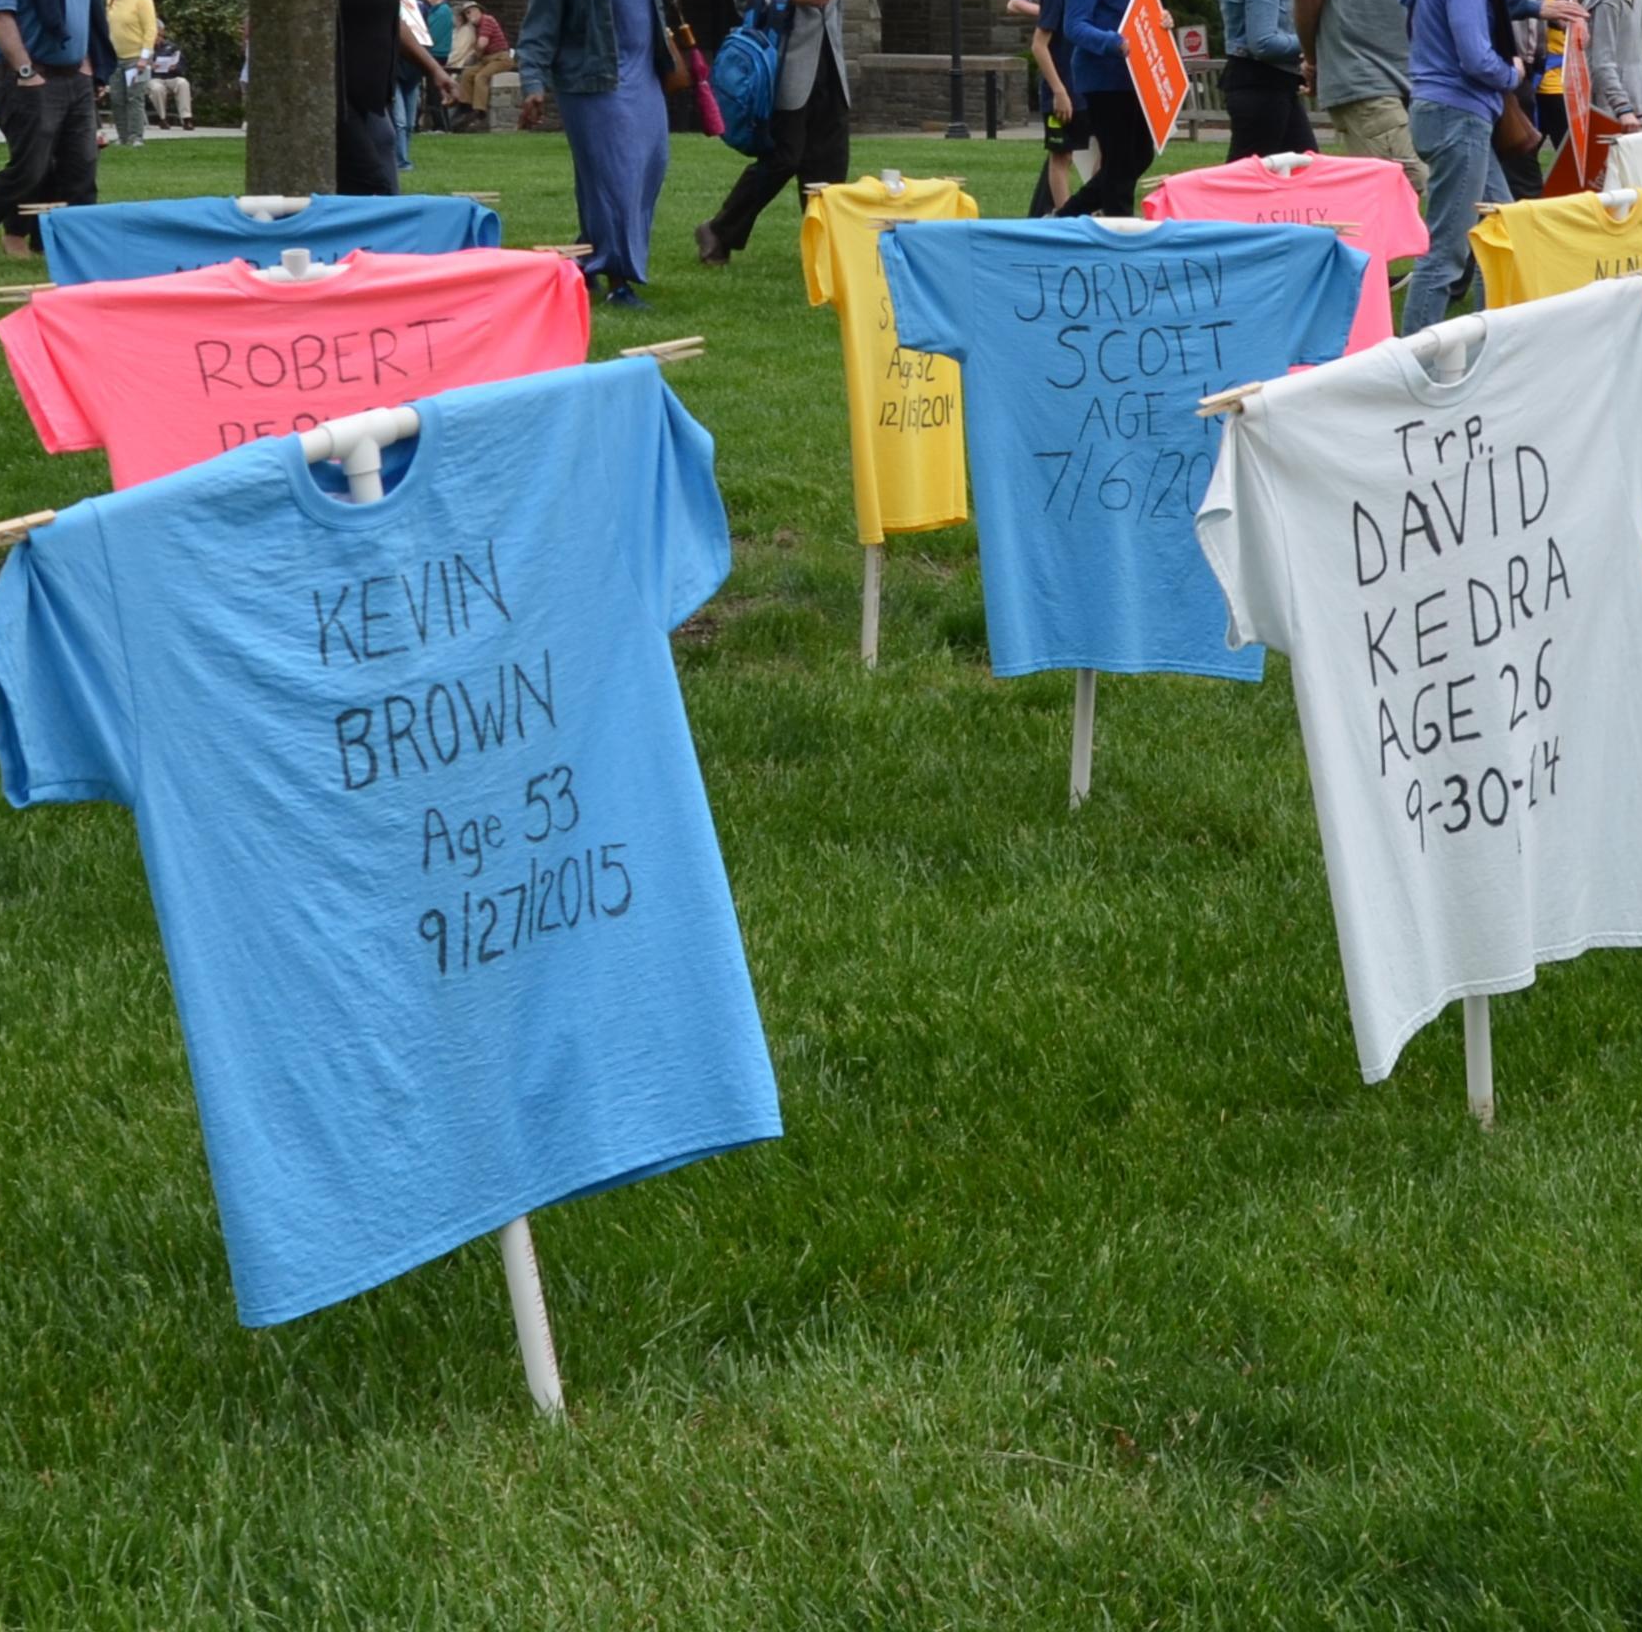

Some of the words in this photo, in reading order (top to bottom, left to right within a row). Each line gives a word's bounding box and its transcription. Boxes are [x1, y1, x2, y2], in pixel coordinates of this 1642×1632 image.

[1009, 252, 1224, 323] JORDAN
[195, 317, 457, 397] ROBERT
[1046, 320, 1235, 390] SCOTT
[1079, 392, 1168, 442] AGE
[312, 540, 512, 667] KEVIN
[1365, 538, 1572, 686] KEDRA
[335, 649, 560, 792] BROWN
[1379, 673, 1481, 776] AGE
[1499, 639, 1553, 732] 26
[422, 806, 505, 879] Age
[524, 764, 582, 844] 53
[1406, 735, 1562, 852] 9-30-14
[417, 842, 634, 977] 9/27/2015
